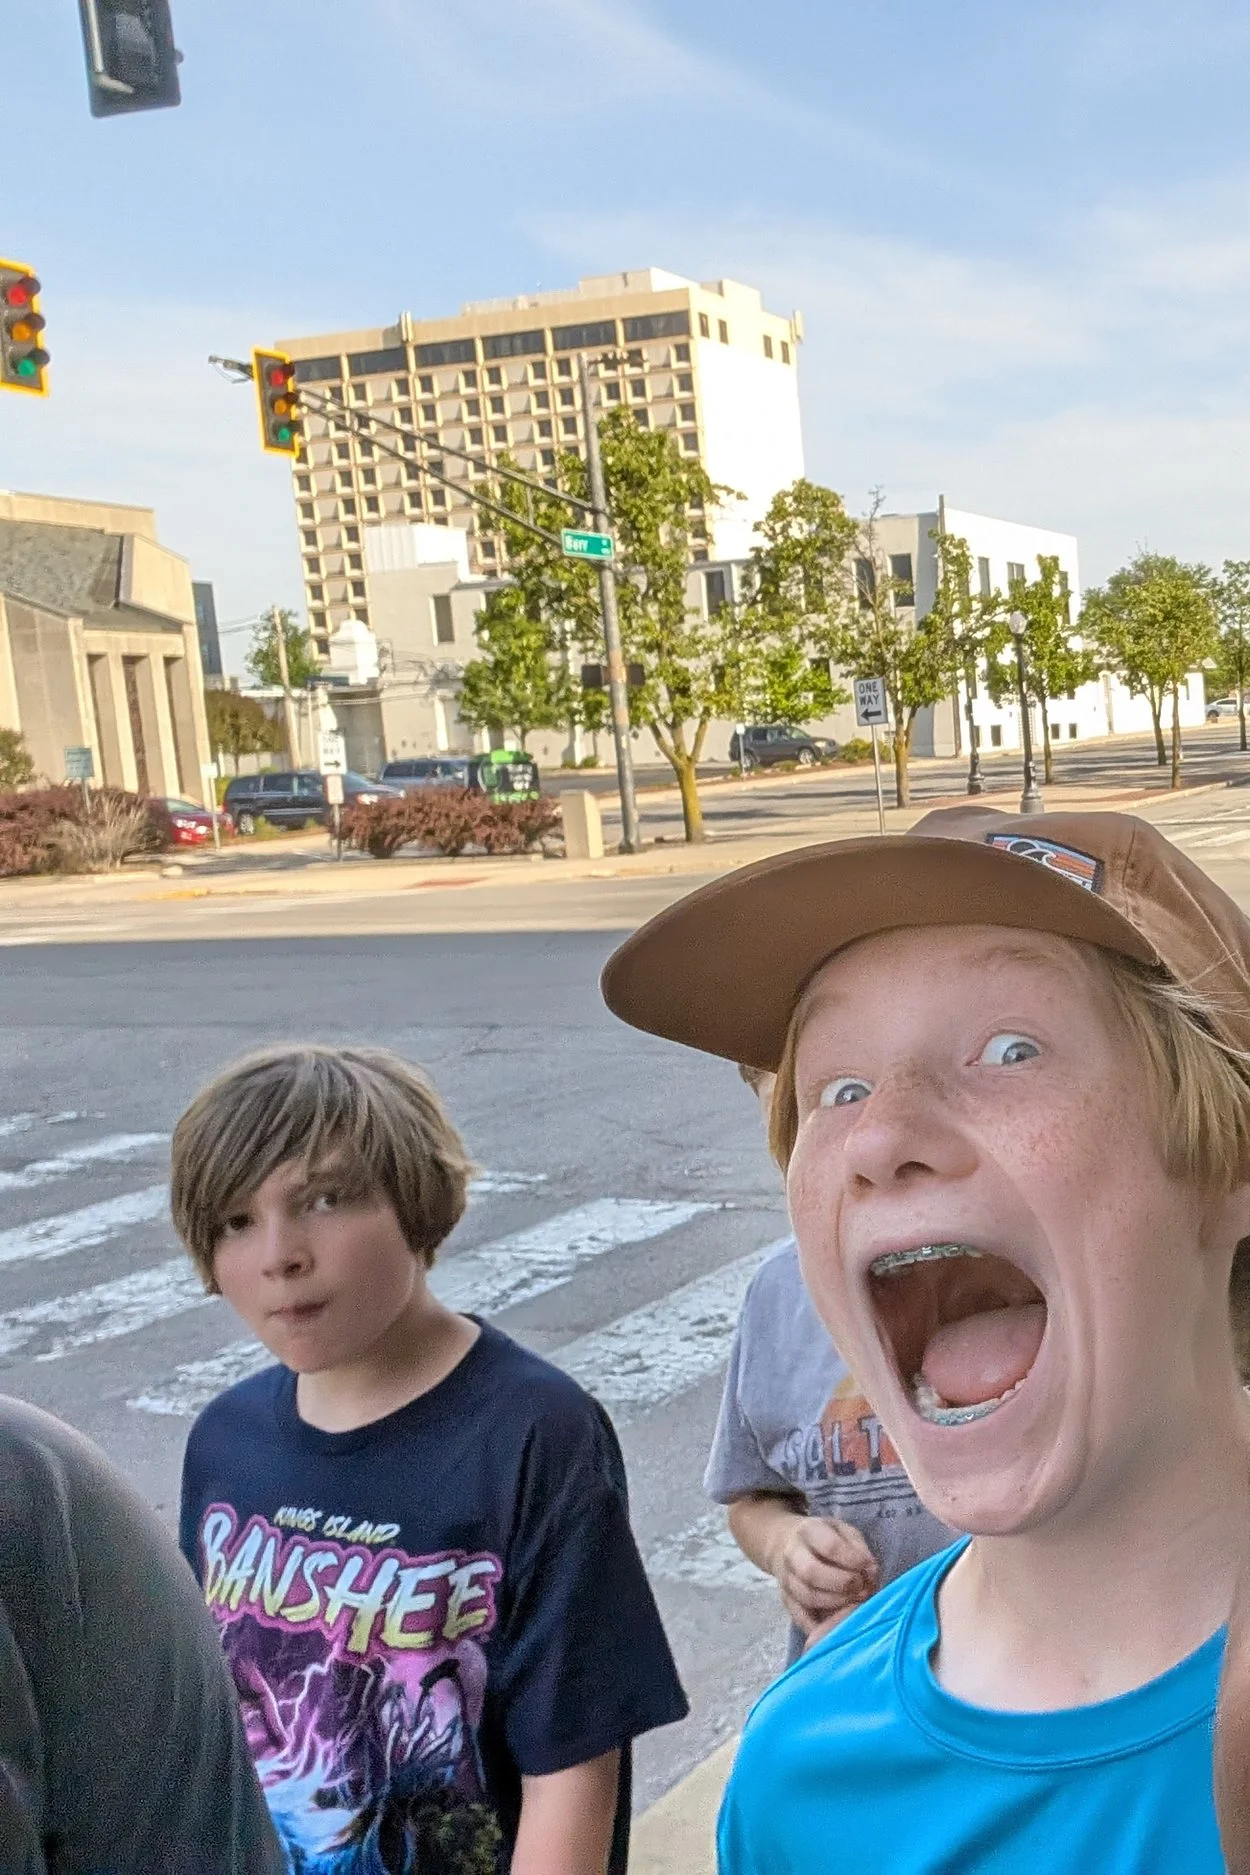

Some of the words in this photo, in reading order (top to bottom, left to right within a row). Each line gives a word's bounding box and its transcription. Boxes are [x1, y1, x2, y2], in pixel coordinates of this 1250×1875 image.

[858, 681, 878, 694] ONE
[859, 694, 880, 706] WAY
[272, 1505, 323, 1532] KINGS
[322, 1515, 400, 1544] ISLAND
[202, 1510, 497, 1654] BANSHEE
